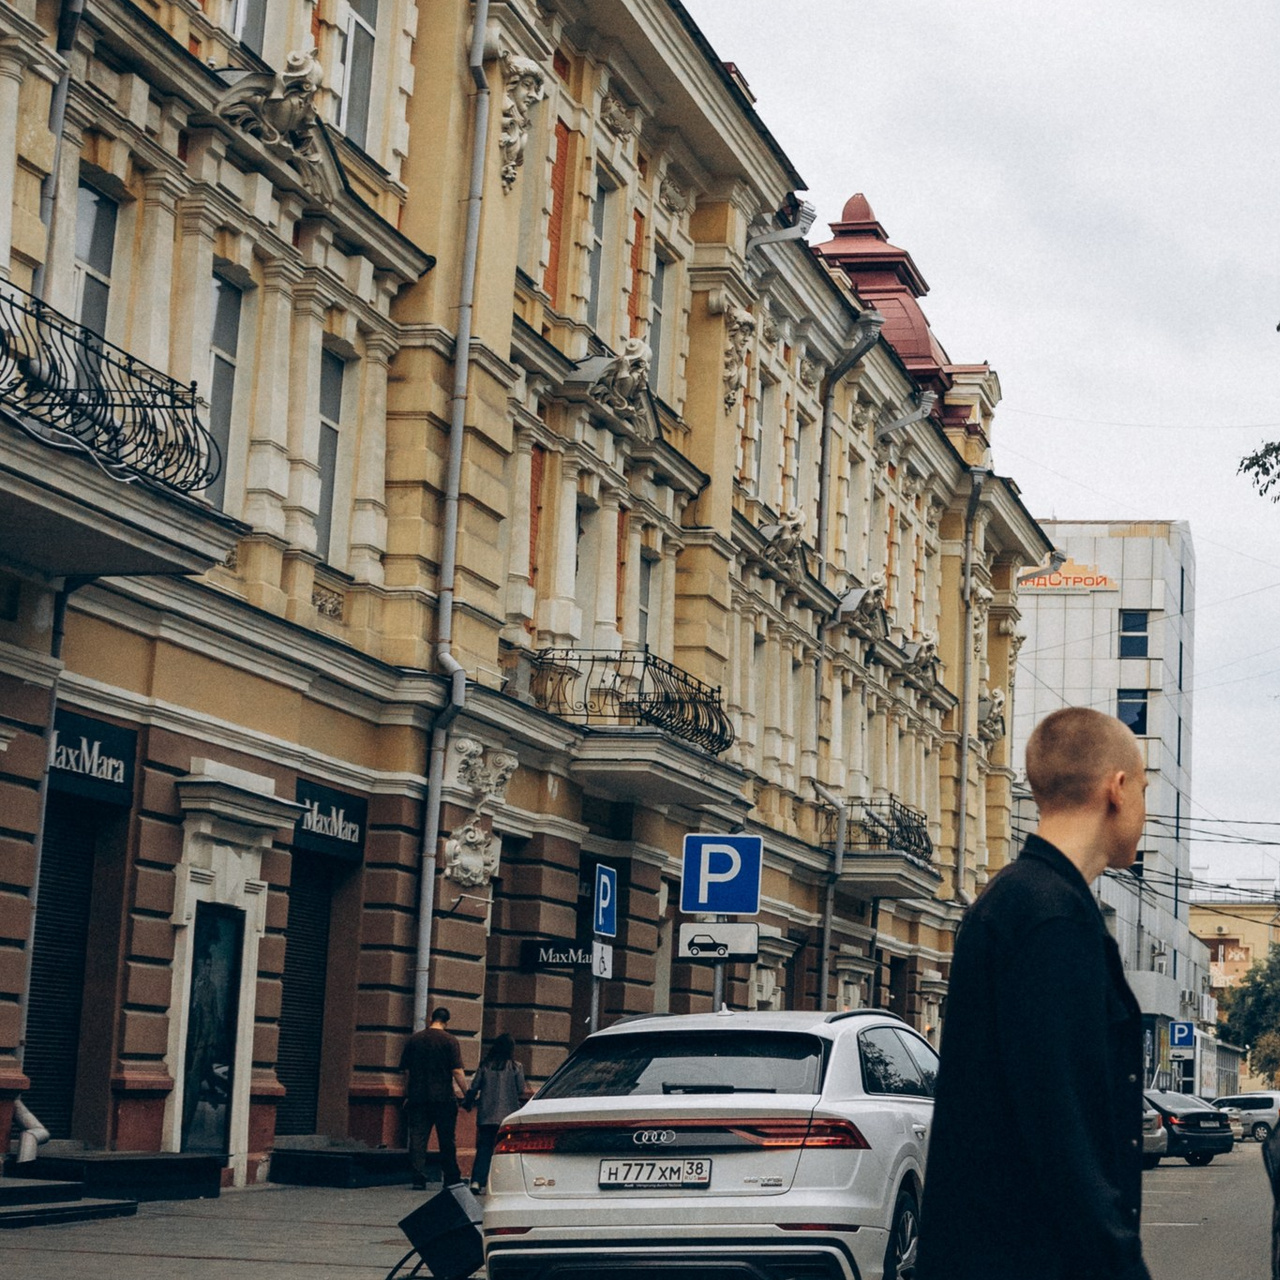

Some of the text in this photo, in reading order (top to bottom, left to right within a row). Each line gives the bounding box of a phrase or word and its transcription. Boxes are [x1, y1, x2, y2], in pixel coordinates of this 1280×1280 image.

[302, 798, 359, 843] MaxMara
[698, 843, 742, 904] P
[599, 874, 611, 925] P
[538, 948, 593, 963] MaxMar
[1174, 1024, 1188, 1044] P
[686, 1162, 703, 1175] 38
